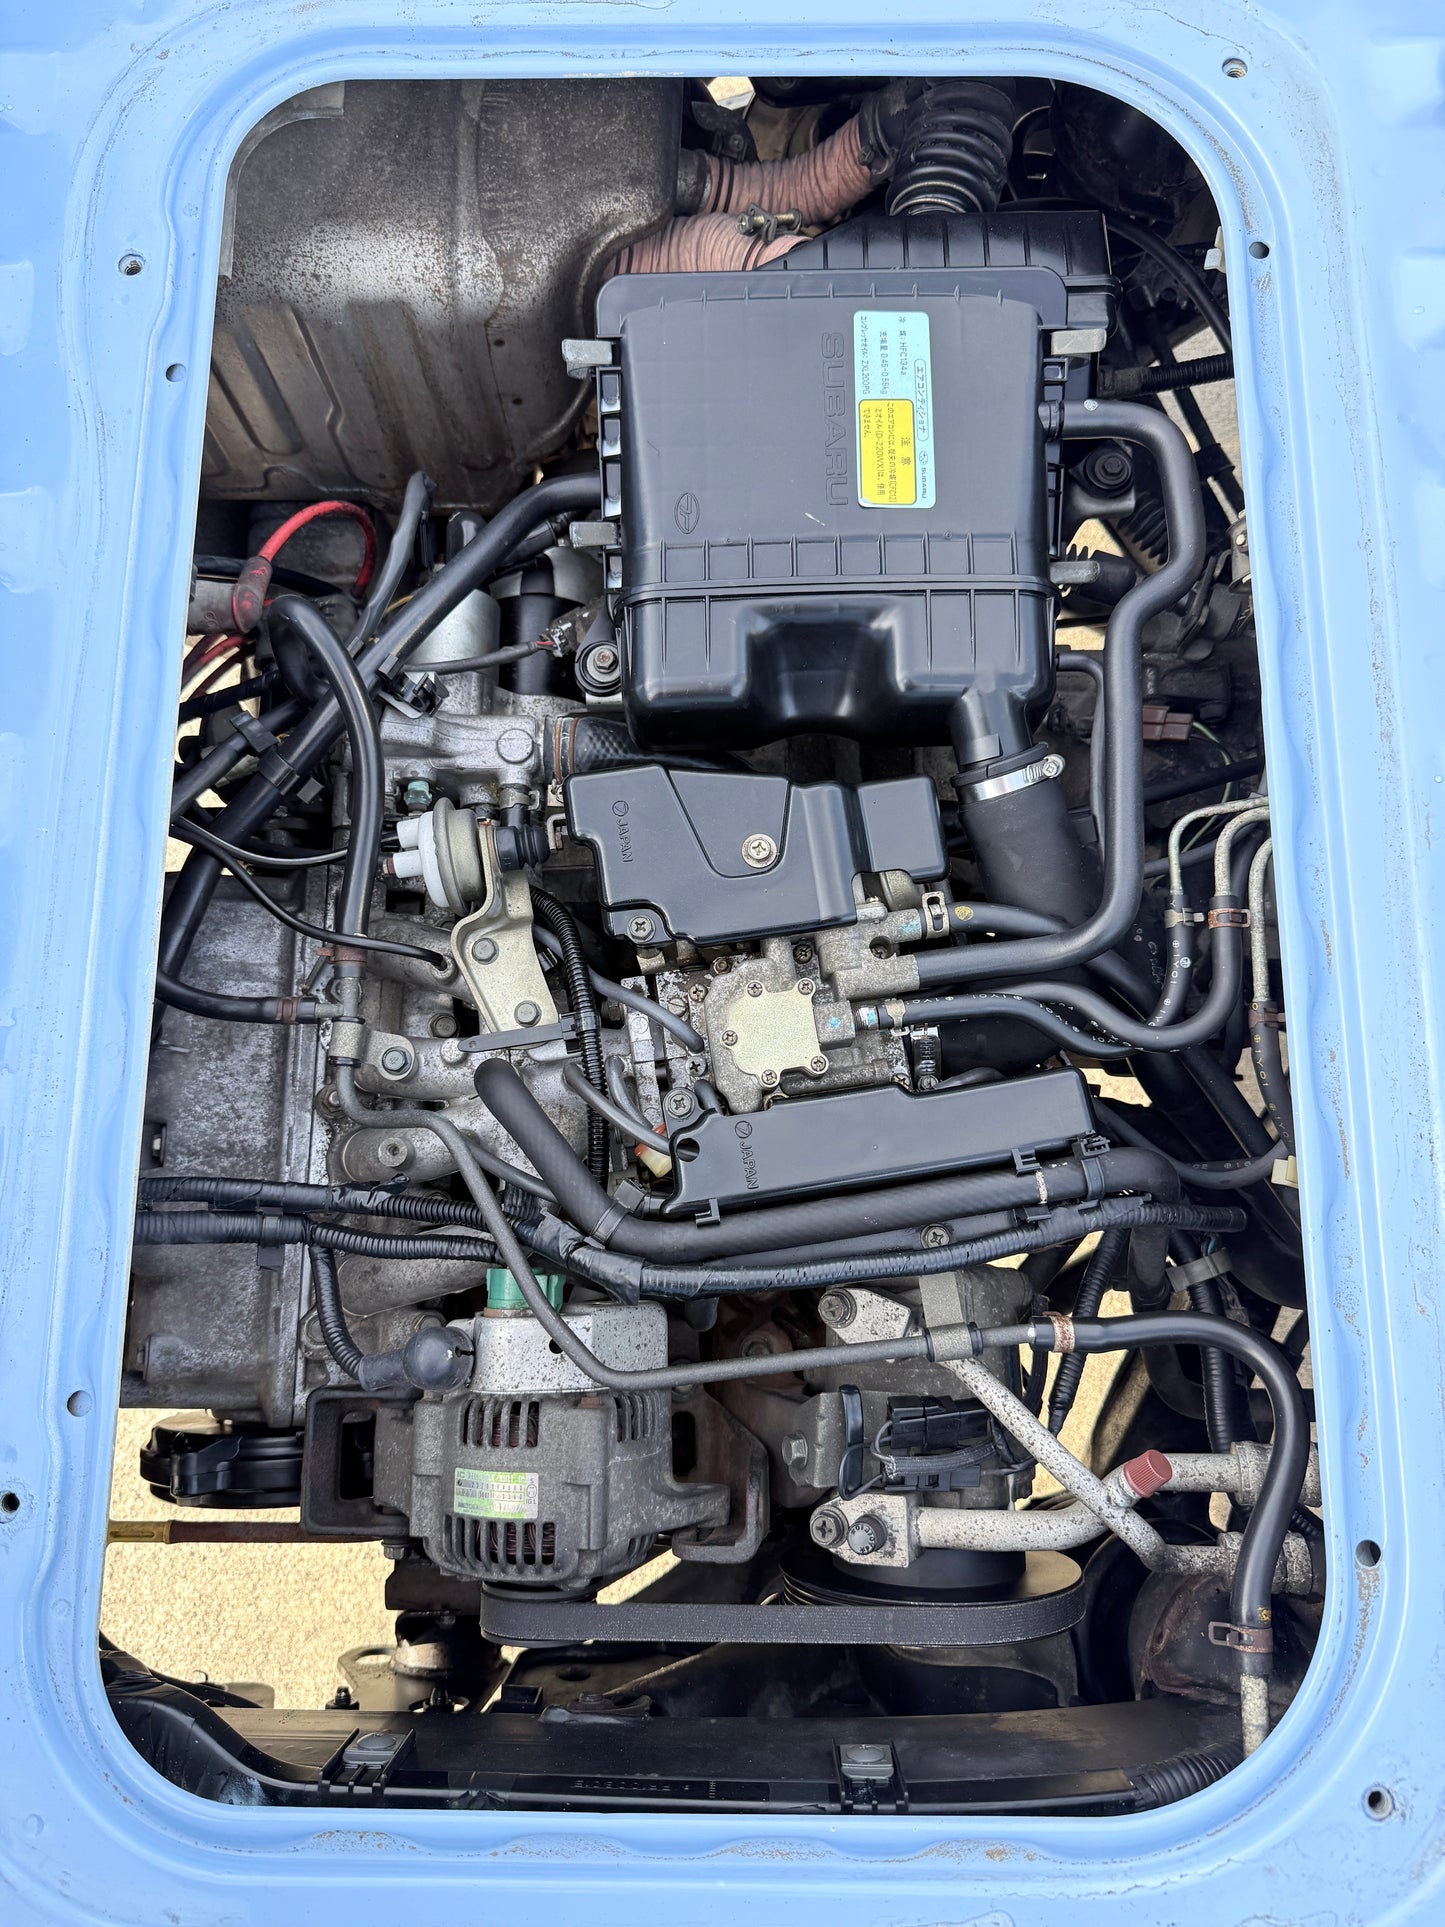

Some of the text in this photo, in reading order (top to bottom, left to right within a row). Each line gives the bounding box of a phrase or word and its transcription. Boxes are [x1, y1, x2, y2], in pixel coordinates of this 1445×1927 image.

[861, 359, 870, 395] ZXL200PG
[899, 342, 908, 376] HFC134a
[821, 331, 849, 506] SUBARU
[617, 819, 633, 863] JAPAN
[740, 1141, 759, 1190] JAPAN
